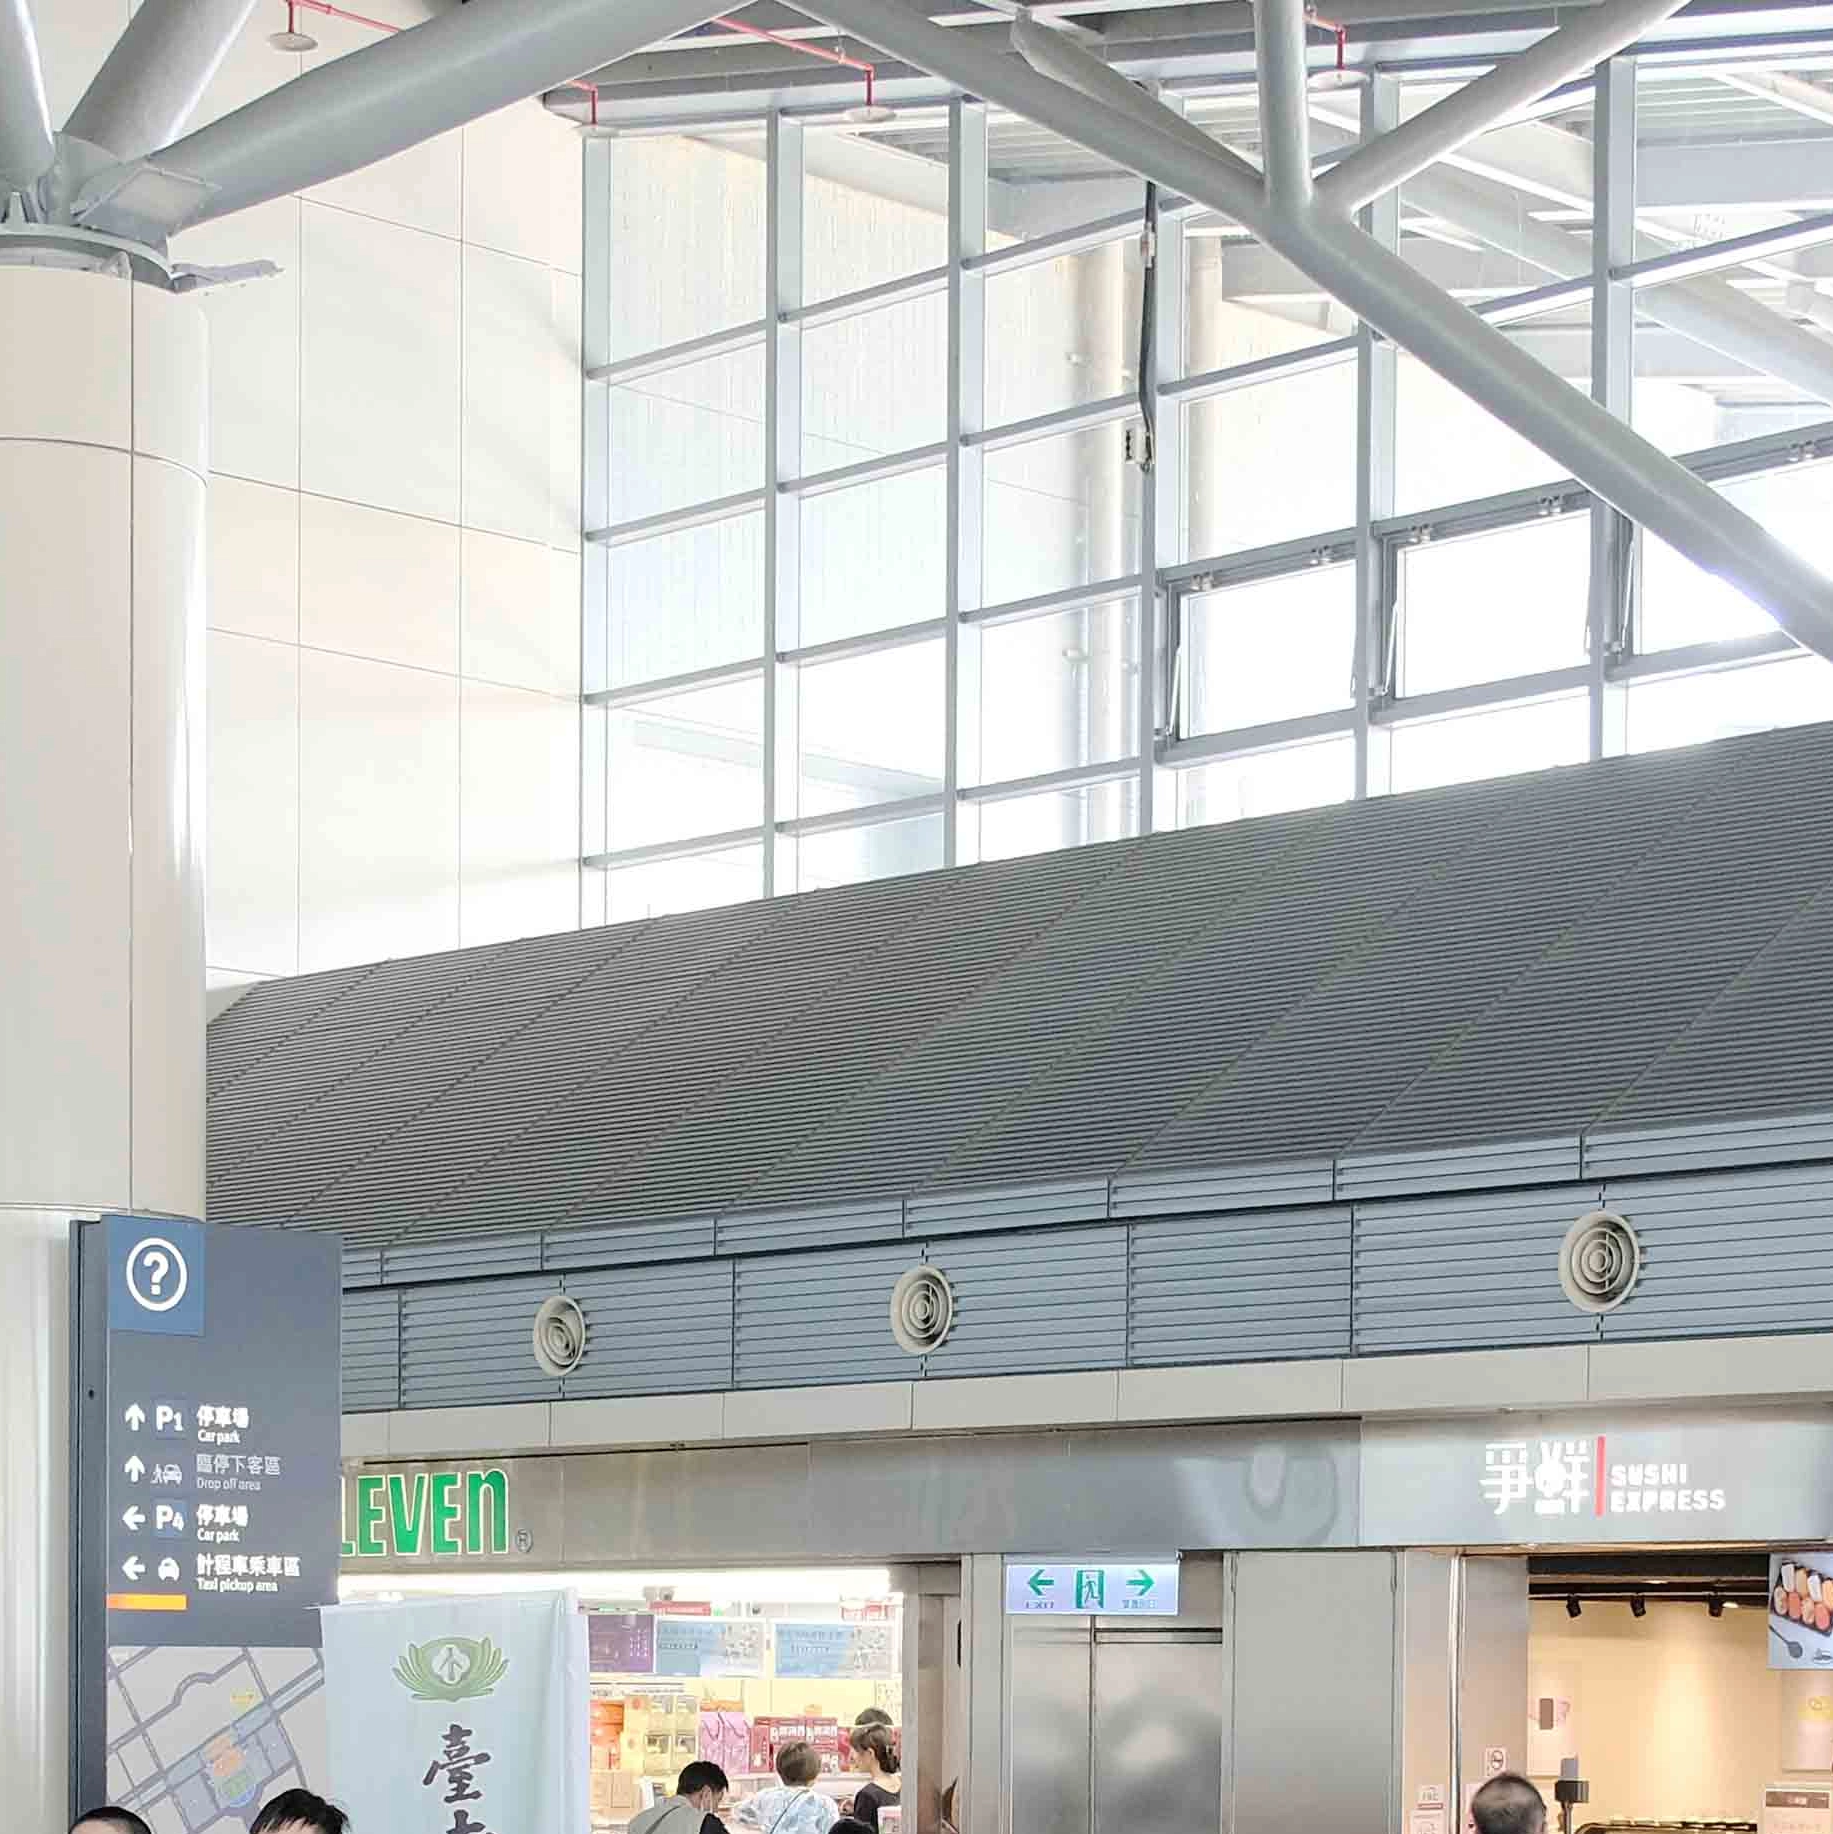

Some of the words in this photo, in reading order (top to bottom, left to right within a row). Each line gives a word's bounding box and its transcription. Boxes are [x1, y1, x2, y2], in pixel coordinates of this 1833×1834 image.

[155, 1405, 184, 1432] P1
[197, 1405, 250, 1429] 停車場
[197, 1430, 216, 1443] Car
[216, 1431, 240, 1445] park
[196, 1478, 221, 1492] Drop
[1610, 1463, 1688, 1487] SUSHI
[1610, 1489, 1726, 1513] EXPRESS
[196, 1504, 249, 1528] 停車場
[196, 1528, 215, 1542] Car
[216, 1529, 240, 1544] park
